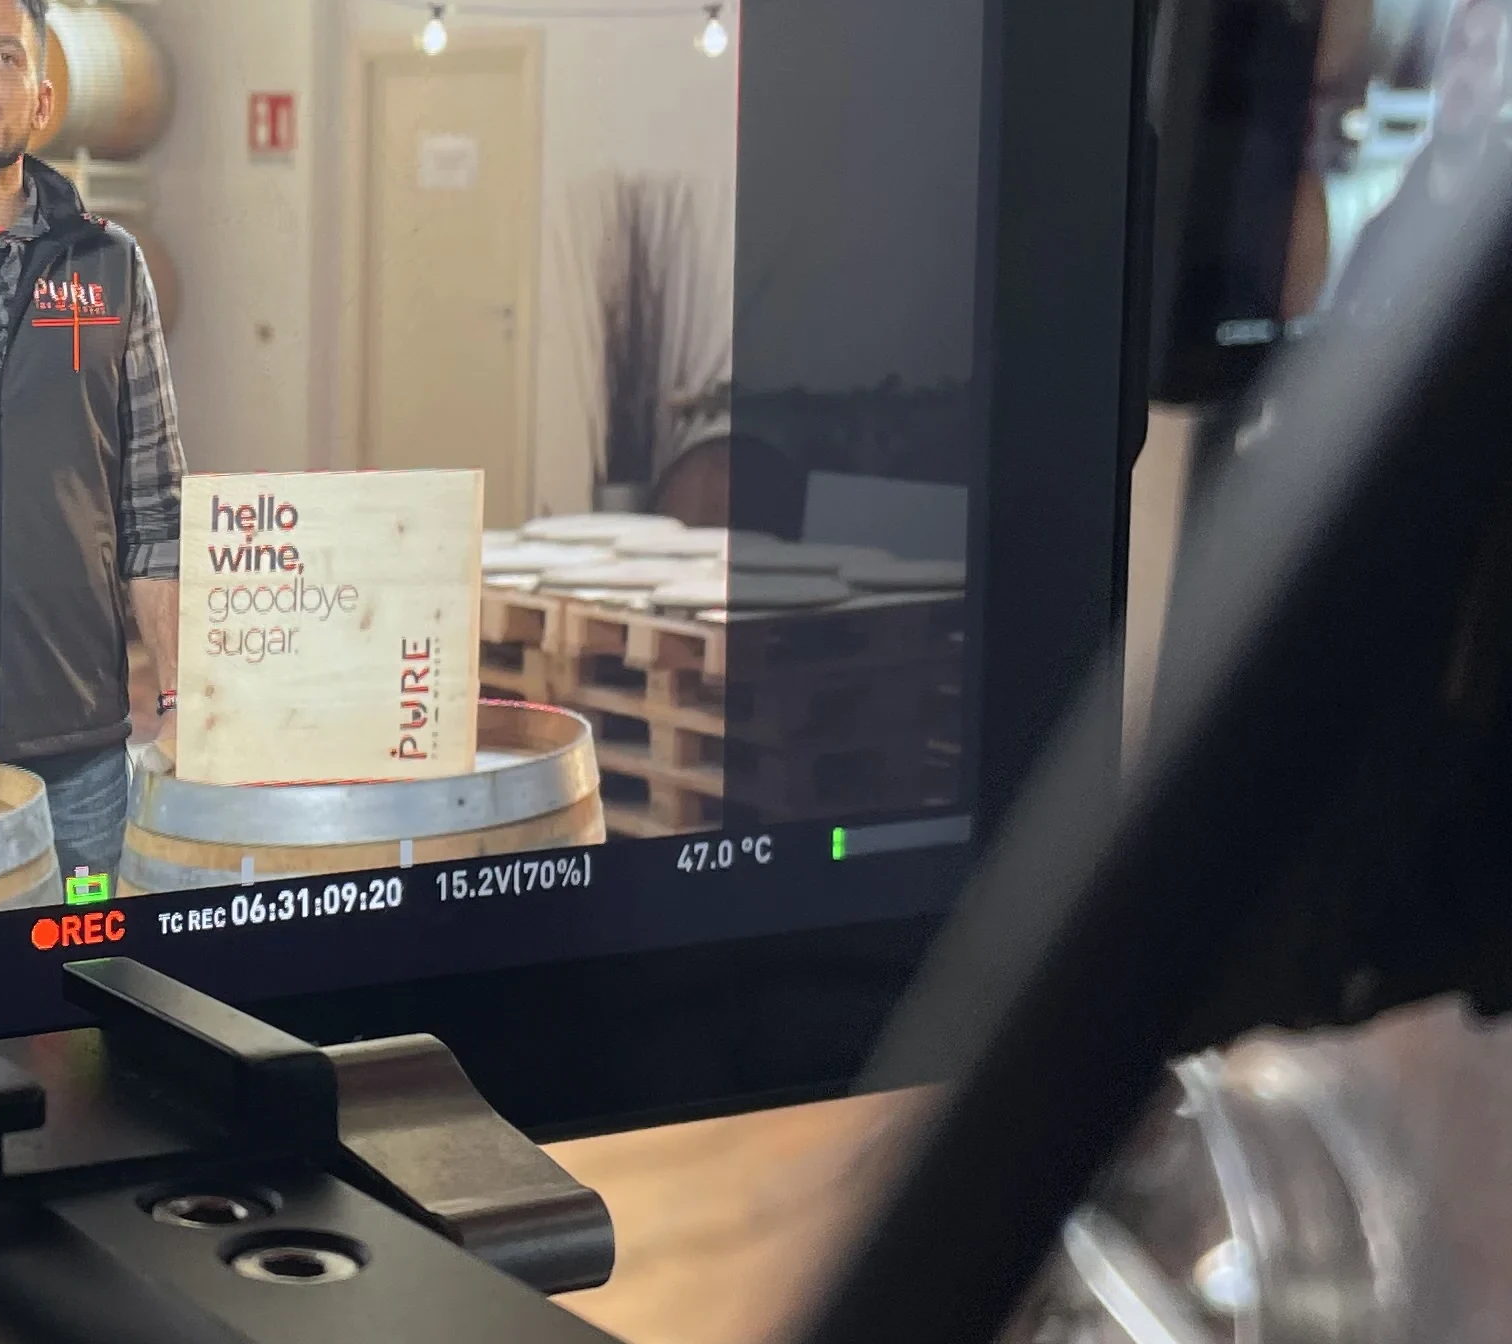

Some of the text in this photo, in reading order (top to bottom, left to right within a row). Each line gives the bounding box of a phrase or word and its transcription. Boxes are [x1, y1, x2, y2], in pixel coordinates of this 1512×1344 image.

[34, 277, 104, 306] PURE
[211, 494, 299, 533] hello
[207, 533, 305, 575] wine,
[207, 577, 360, 623] goodbye
[206, 626, 300, 663] sugar.
[399, 636, 432, 761] PURE
[677, 840, 733, 873] 47.0
[436, 854, 591, 902] 15.2V(70%)
[158, 877, 403, 935] TC REC 06:31:09:20
[61, 910, 127, 946] REC
